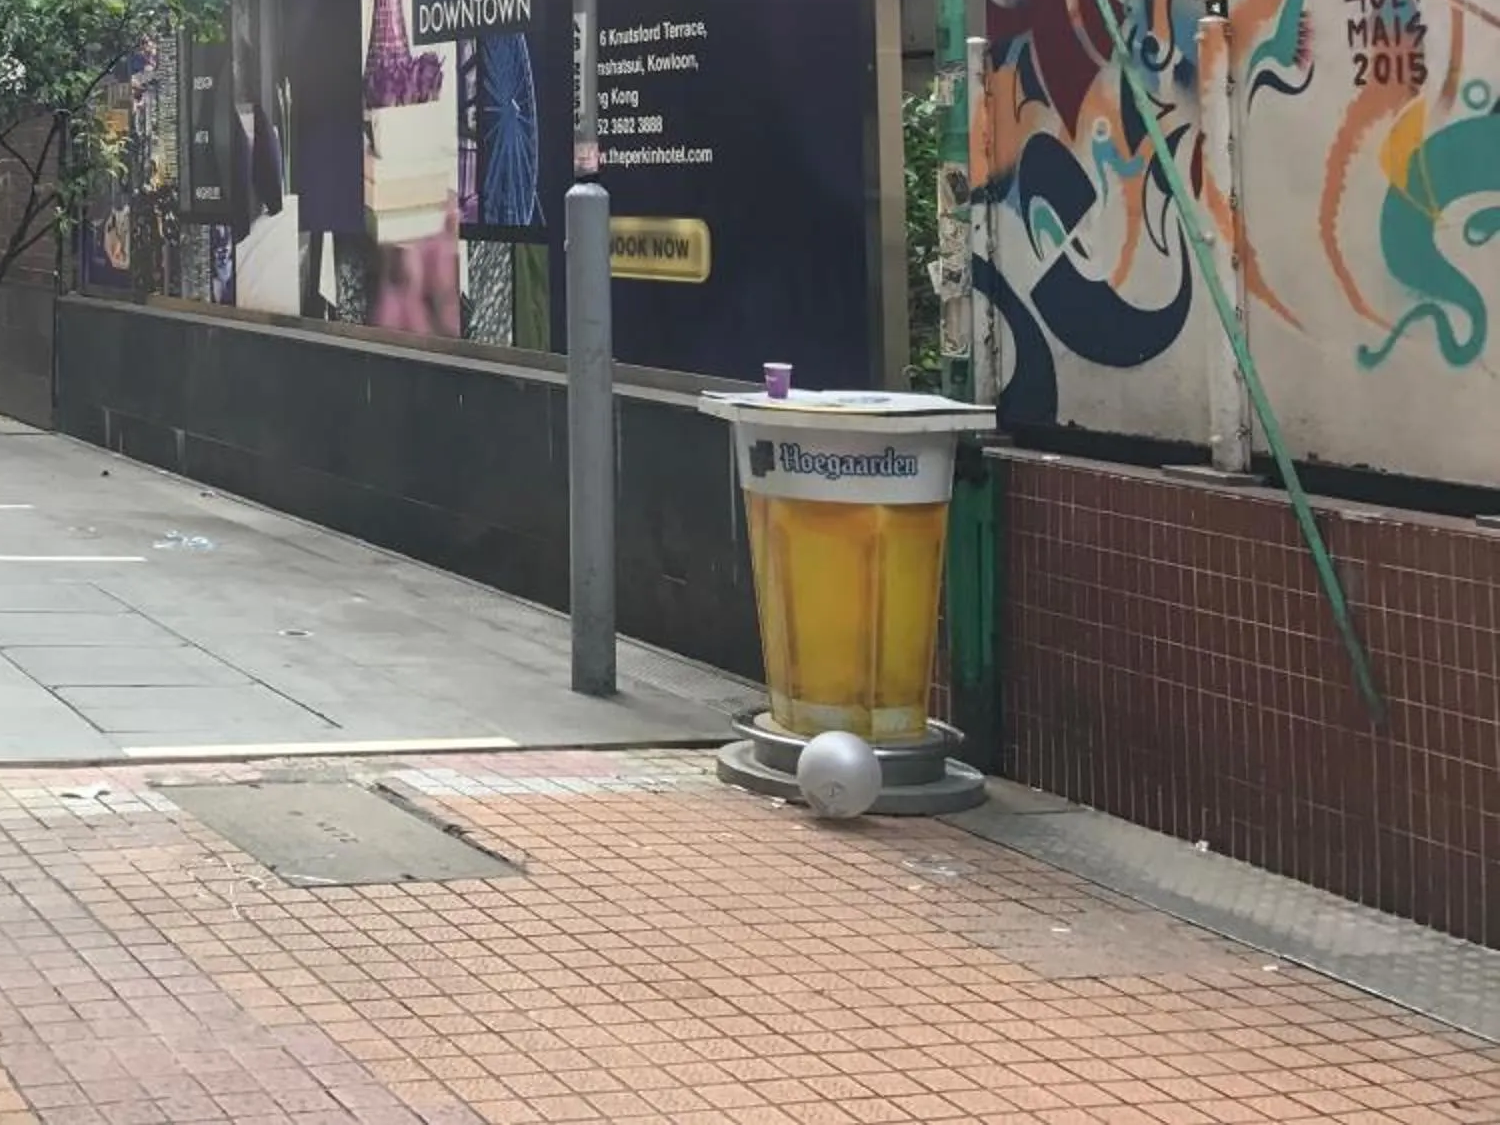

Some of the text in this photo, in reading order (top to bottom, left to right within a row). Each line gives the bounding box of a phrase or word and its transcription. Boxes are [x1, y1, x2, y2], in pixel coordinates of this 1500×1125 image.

[663, 21, 708, 39] Terrace,
[647, 52, 699, 72] Kowloon,
[1352, 52, 1428, 87] 2015
[611, 87, 639, 108] Kong
[653, 238, 689, 260] NOW
[779, 442, 918, 481] Hoegaarden
